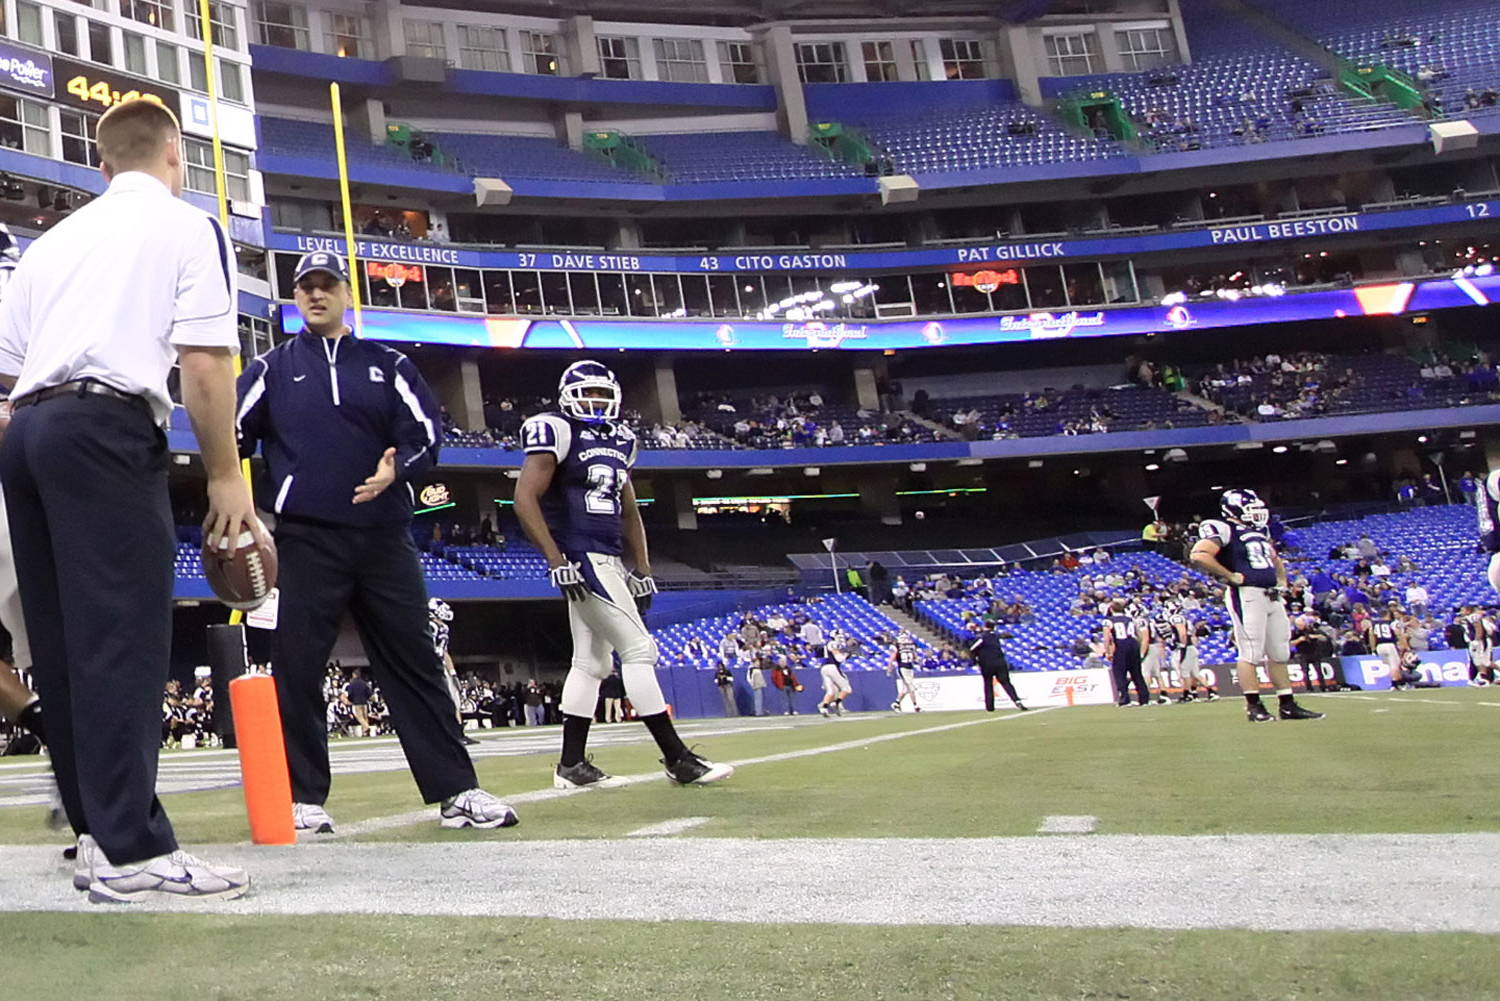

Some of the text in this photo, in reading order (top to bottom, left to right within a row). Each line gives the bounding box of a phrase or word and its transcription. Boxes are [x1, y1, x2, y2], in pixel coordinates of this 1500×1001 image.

[11, 58, 45, 79] Power
[1465, 203, 1490, 218] 12
[1211, 216, 1359, 244] PAUL BEESTON
[297, 237, 342, 253] LEVEL
[371, 243, 459, 264] EXCELLENCE
[958, 243, 1065, 262] PAT GILLICK
[311, 253, 329, 266] C
[518, 254, 640, 270] 37 DAVE STIEB
[700, 255, 846, 270] 43 CITO GASTON
[525, 421, 547, 445] 21
[1114, 623, 1135, 639] 84
[1374, 624, 1392, 639] 49
[1056, 676, 1089, 685] BIG
